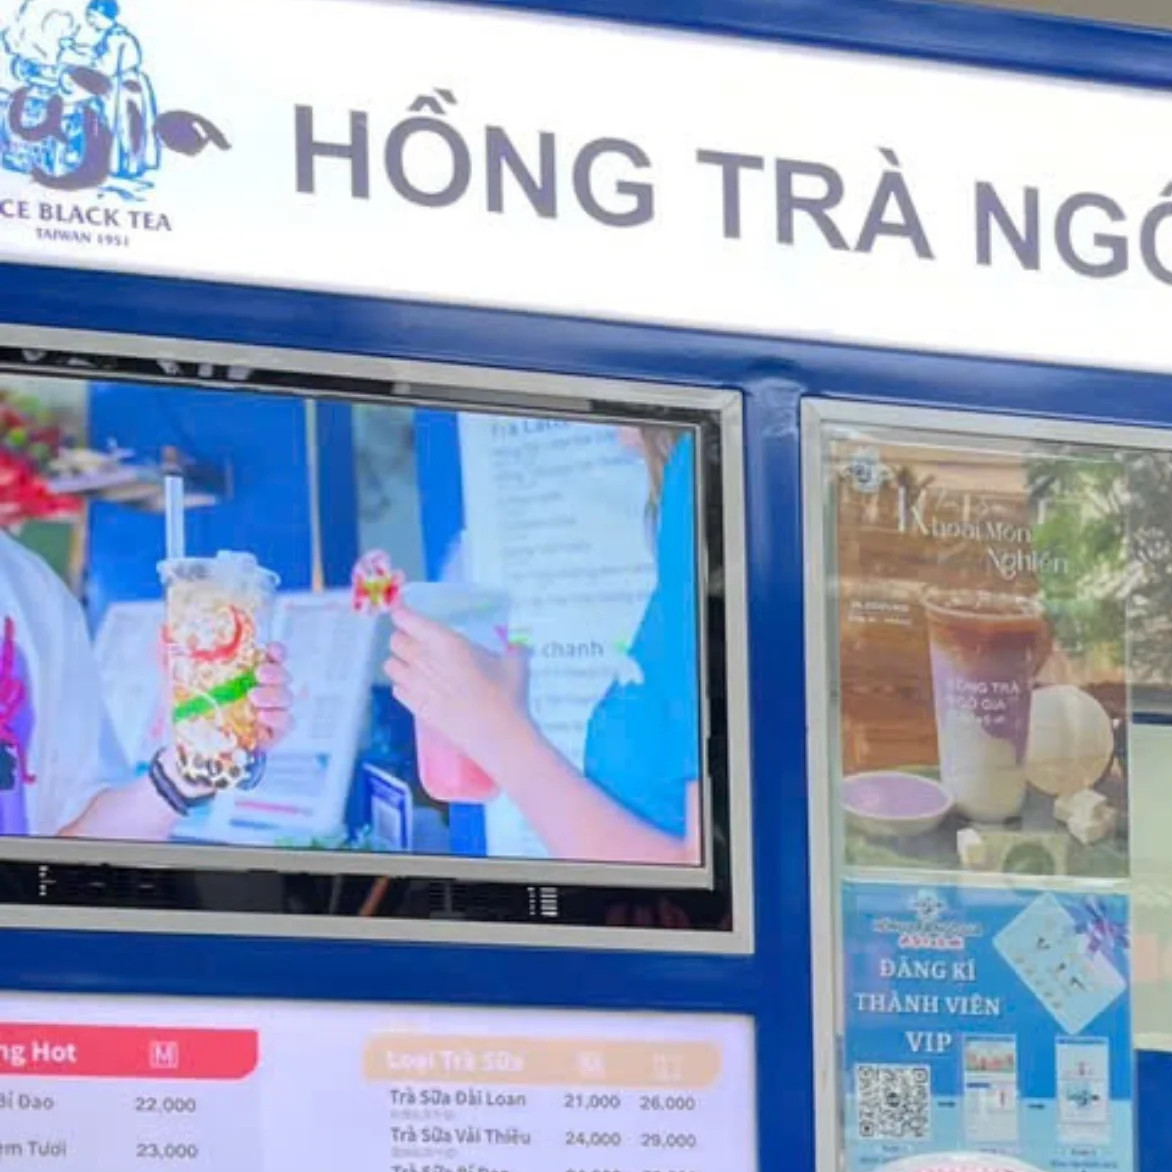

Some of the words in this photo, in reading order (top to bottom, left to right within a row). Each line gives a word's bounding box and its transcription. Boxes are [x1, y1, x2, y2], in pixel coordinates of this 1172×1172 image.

[294, 88, 655, 227] HỒNG
[697, 147, 934, 259] TRÀ
[39, 202, 120, 227] BLACK
[128, 211, 172, 231] TEA
[35, 228, 91, 244] TAIWAN
[97, 233, 130, 247] 1951
[880, 956, 946, 979] ĐĂNG
[855, 990, 938, 1014] THÀNH
[945, 993, 1000, 1015] VIÊN
[31, 1041, 77, 1063] Hot
[905, 1031, 952, 1053] VIP
[390, 1089, 416, 1105] Trà
[419, 1089, 452, 1106] Sữa
[487, 1091, 526, 1107] Loan
[564, 1095, 620, 1110] 21,000
[391, 1127, 417, 1142] Trà
[421, 1126, 452, 1143] Sữa
[565, 1133, 621, 1147] 24,000
[642, 1134, 696, 1148] 29,000
[28, 1142, 67, 1157] Tươi
[136, 1144, 198, 1159] 23,000
